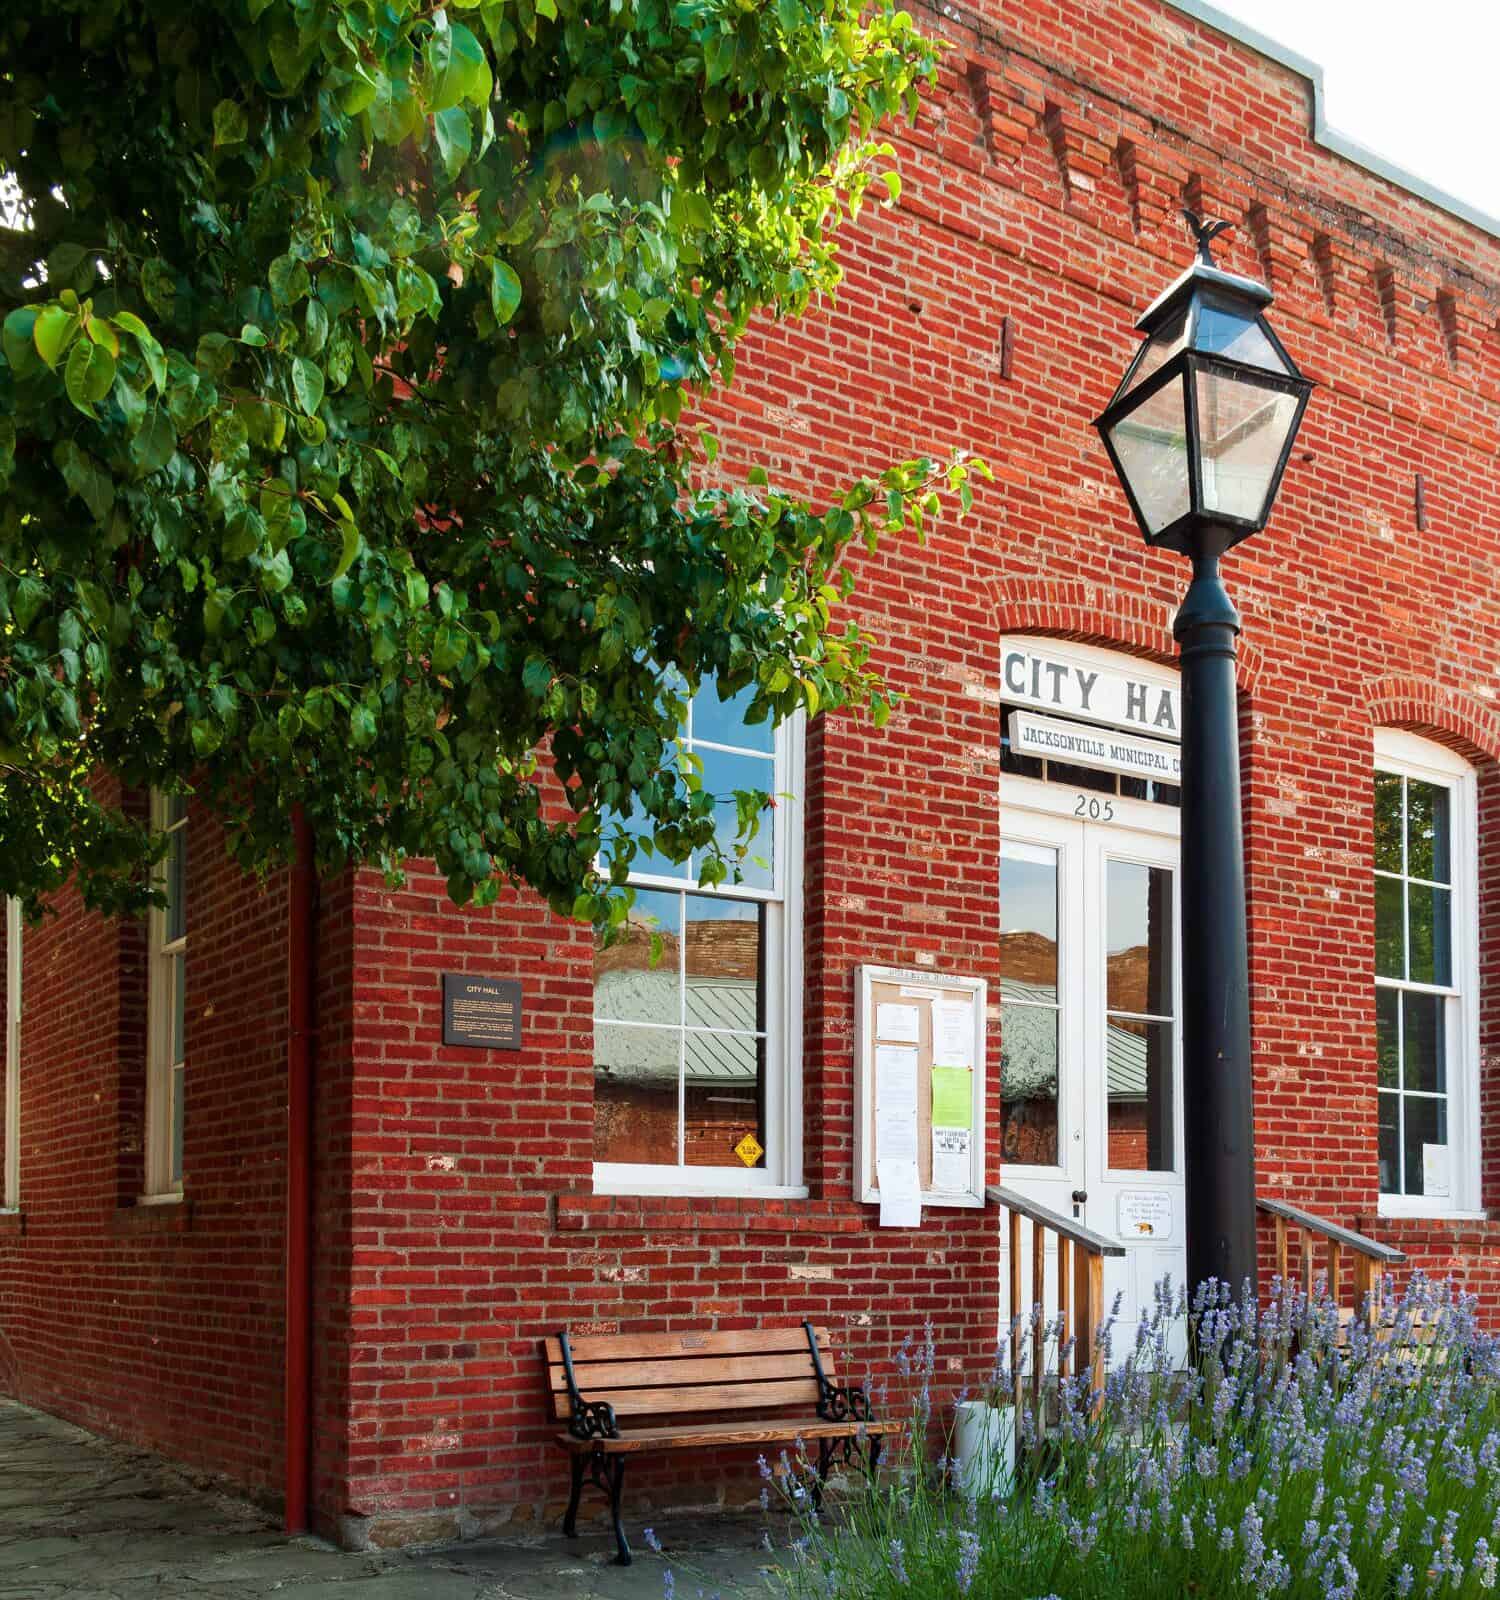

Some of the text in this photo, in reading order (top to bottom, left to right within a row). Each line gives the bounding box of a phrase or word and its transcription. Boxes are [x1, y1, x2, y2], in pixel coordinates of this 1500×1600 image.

[1005, 652, 1176, 730] CITY HA
[1023, 727, 1105, 758] JACKSONVILLE
[1109, 744, 1169, 770] MUNICIPAL
[1074, 794, 1114, 821] 205
[466, 985, 499, 994] CITY HALL
